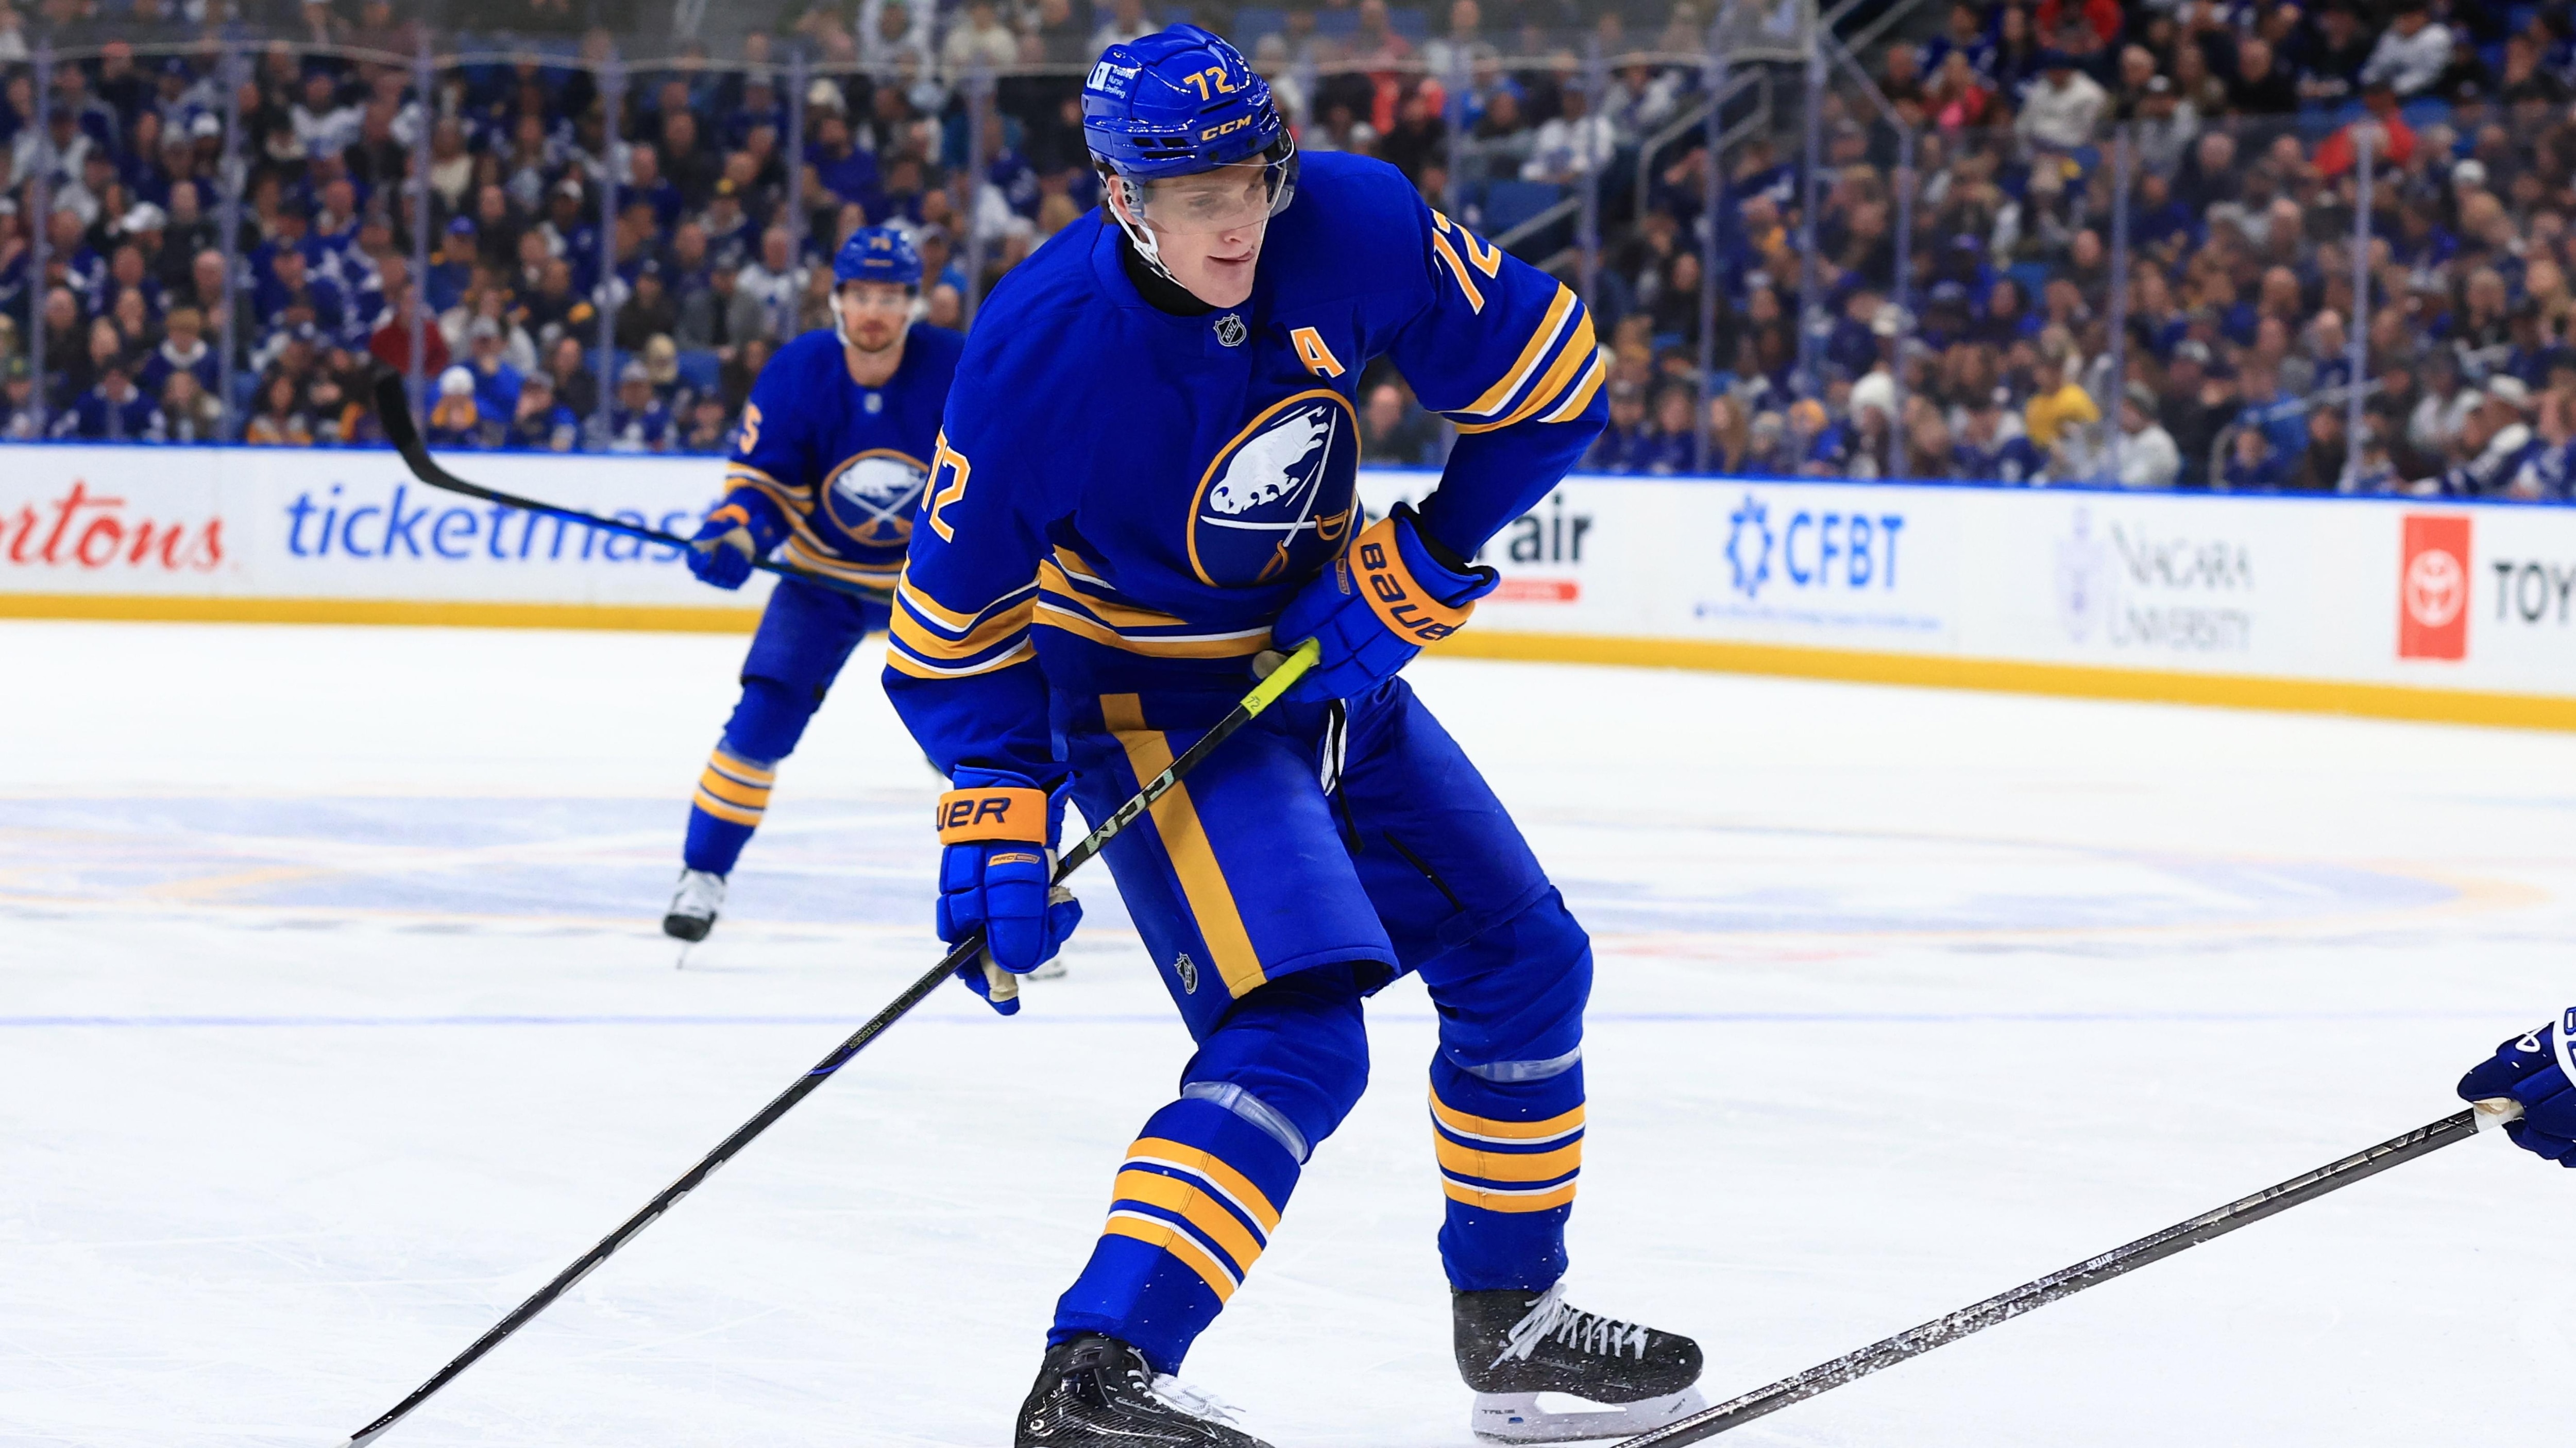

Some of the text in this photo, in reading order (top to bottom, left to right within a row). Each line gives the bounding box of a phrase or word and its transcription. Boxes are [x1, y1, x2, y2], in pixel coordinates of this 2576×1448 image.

[1108, 75, 1124, 87] Nurse
[1184, 66, 1235, 101] 72
[1200, 114, 1252, 142] CCM
[1430, 208, 1502, 316] 72
[1290, 326, 1346, 378] A
[0, 480, 223, 570] rtons
[285, 483, 722, 565] ticketmas
[1476, 492, 1591, 563] air
[1785, 510, 1906, 589] CFBT
[2493, 560, 2576, 624] TOY
[1246, 695, 1260, 710] 72
[1083, 768, 1176, 856] CCM
